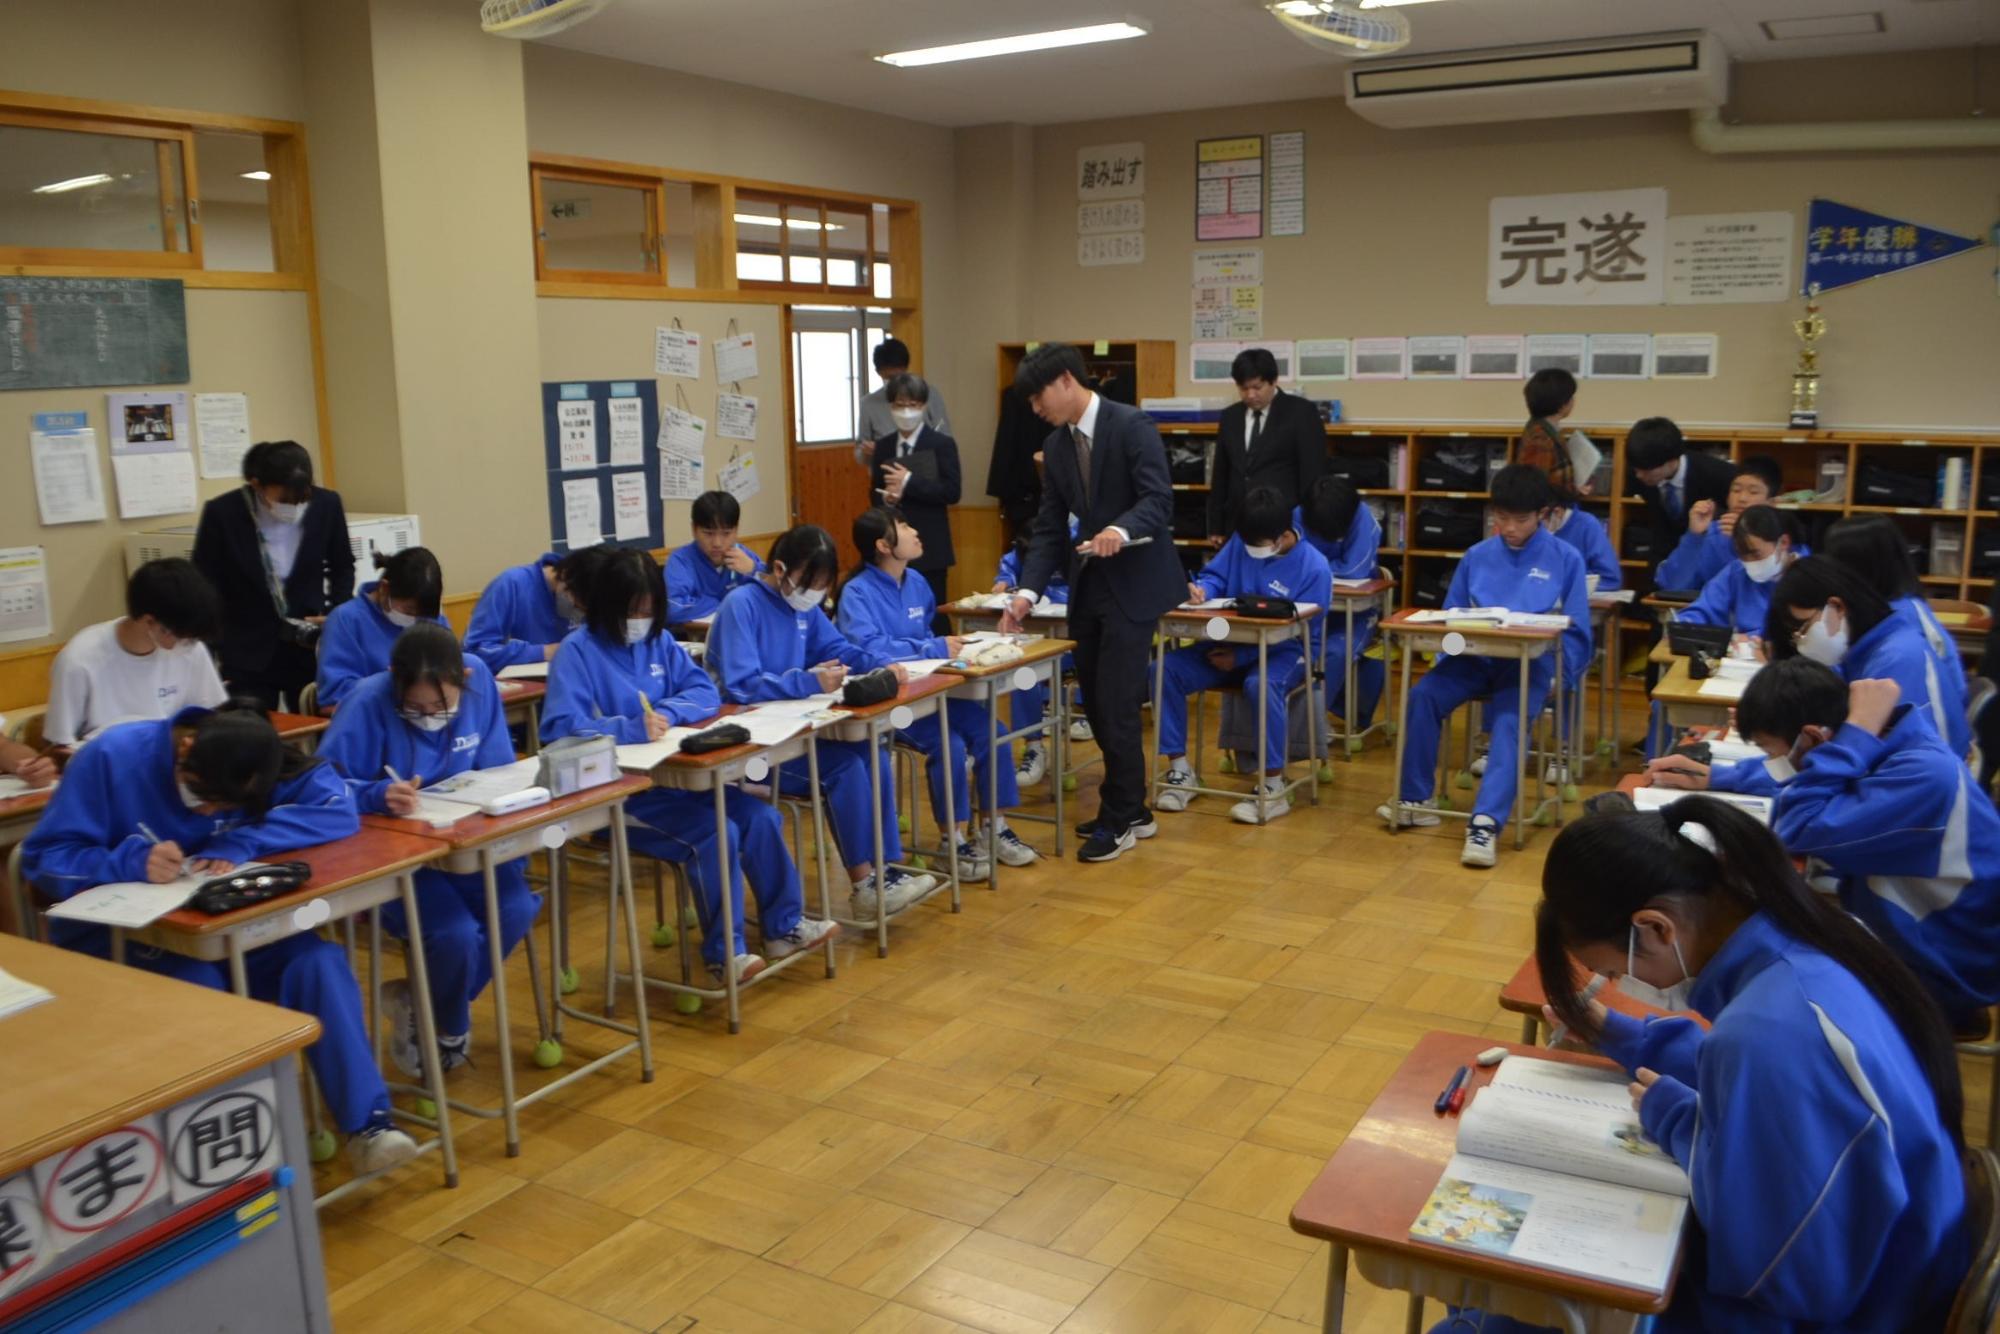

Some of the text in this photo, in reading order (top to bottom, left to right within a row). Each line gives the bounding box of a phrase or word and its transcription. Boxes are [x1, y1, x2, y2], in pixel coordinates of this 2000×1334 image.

[1081, 157, 1142, 189] 踏み出す
[1499, 211, 1646, 289] 完遂
[1808, 225, 1918, 251] 学年優勝
[57, 1136, 146, 1219] ま
[188, 1100, 265, 1184] 問
